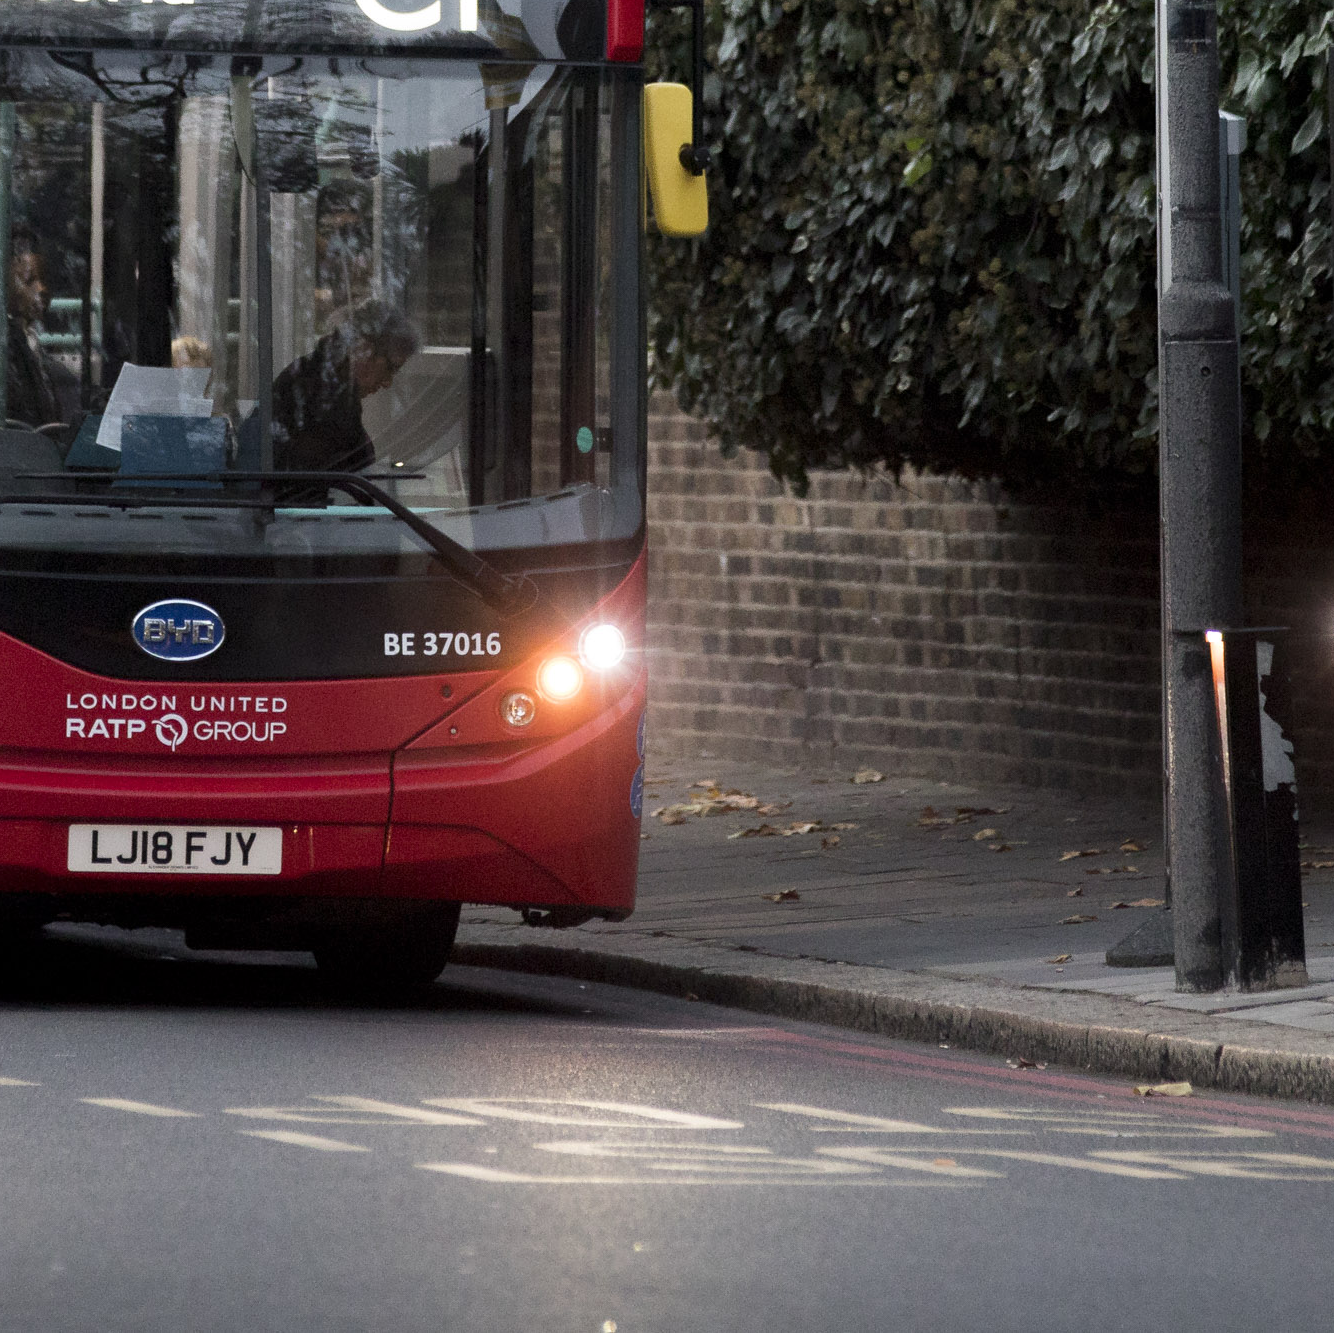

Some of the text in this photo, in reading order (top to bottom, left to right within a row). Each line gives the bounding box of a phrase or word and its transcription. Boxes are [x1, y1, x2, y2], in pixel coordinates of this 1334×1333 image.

[142, 617, 215, 645] BYD
[384, 632, 502, 656] BE 37016
[67, 693, 288, 713] LONDON UNITED
[66, 718, 287, 742] RATP GROUP
[90, 829, 257, 866] LJ18 FJY
